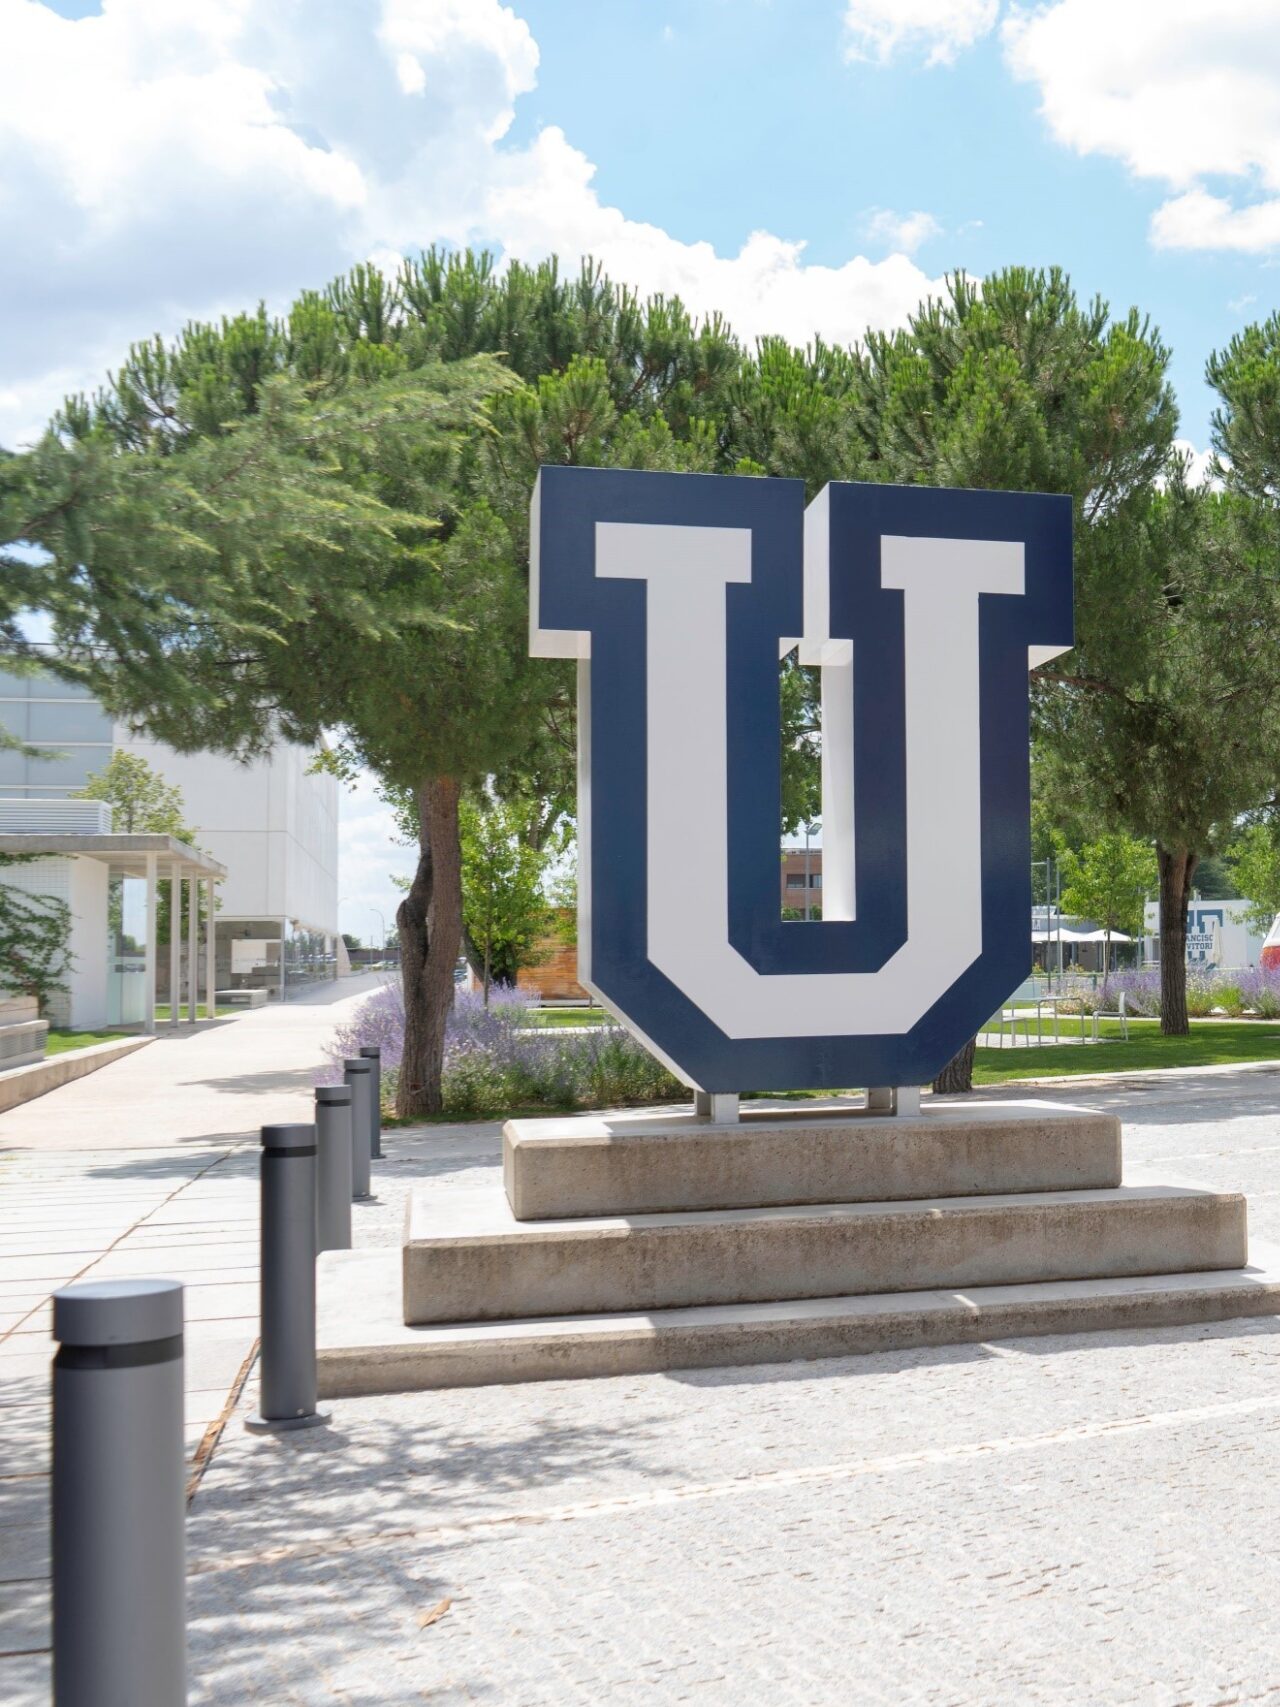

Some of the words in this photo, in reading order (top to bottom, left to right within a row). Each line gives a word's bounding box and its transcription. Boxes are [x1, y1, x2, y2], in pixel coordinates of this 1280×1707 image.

[532, 466, 1075, 1092] U
[1186, 934, 1214, 942] ANCISC
[1186, 942, 1213, 950] VITORI
